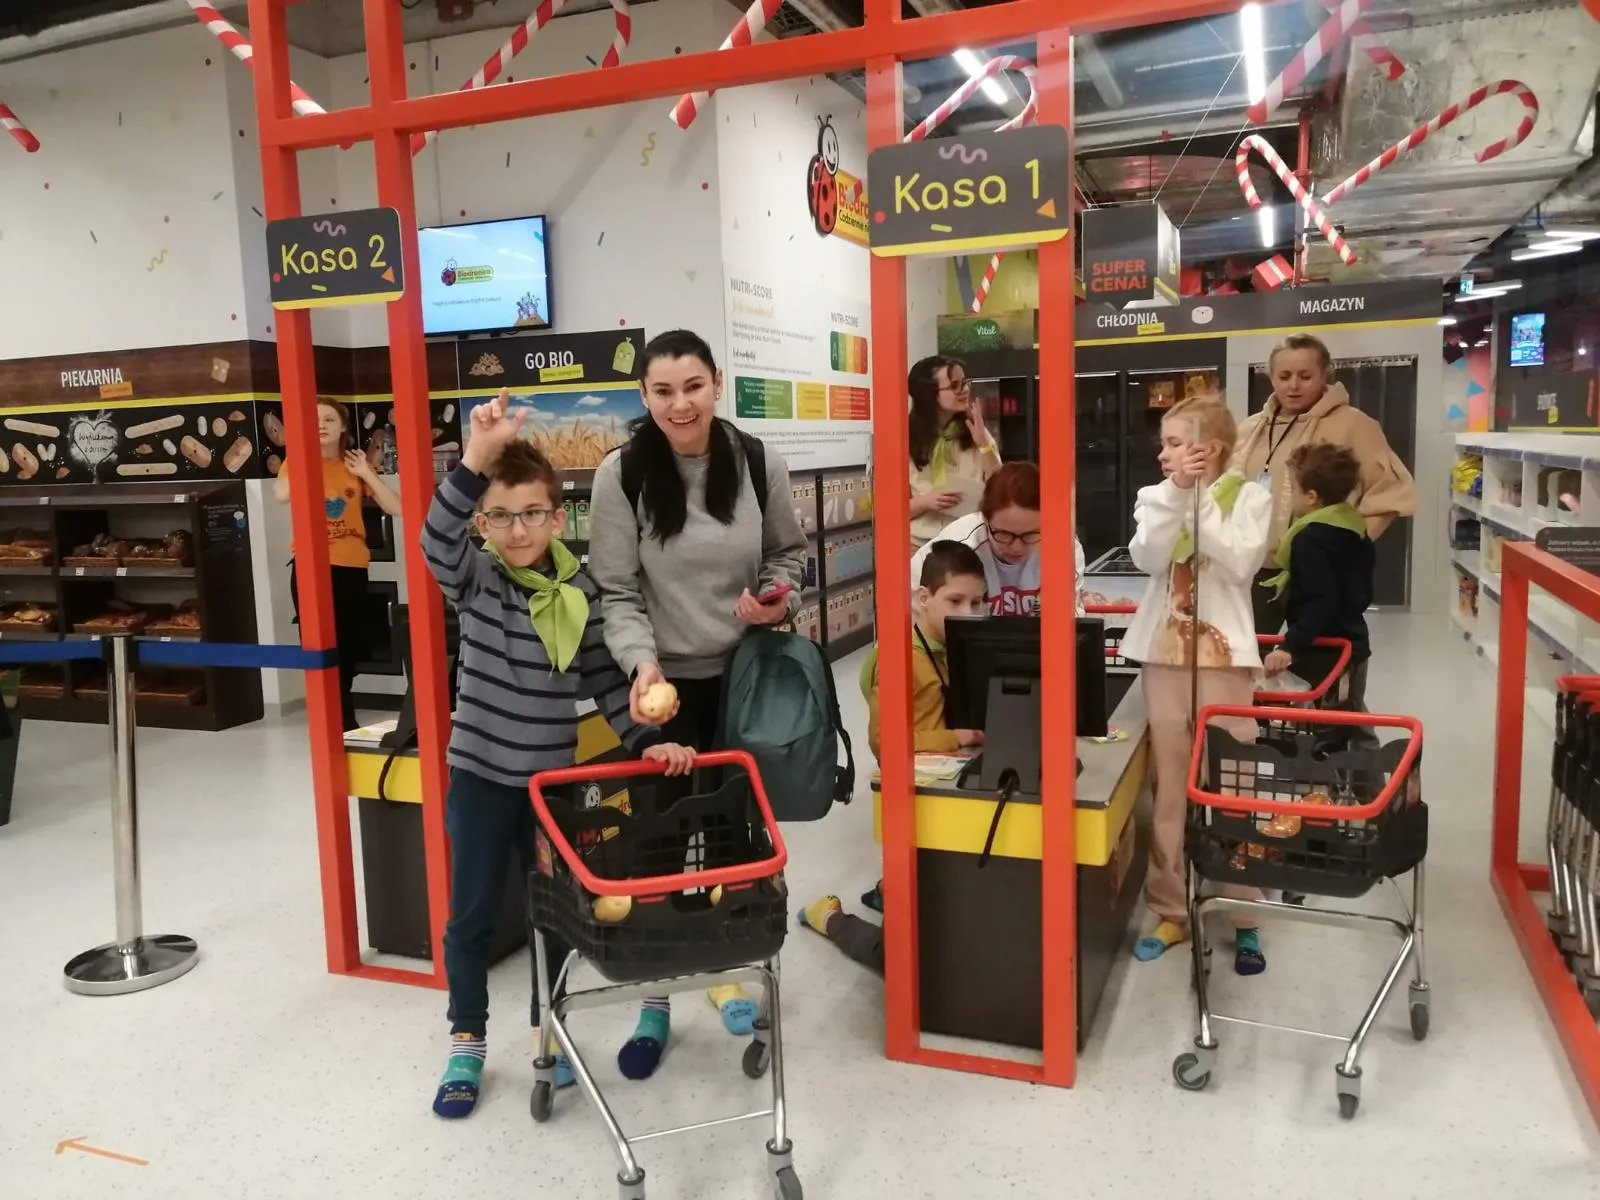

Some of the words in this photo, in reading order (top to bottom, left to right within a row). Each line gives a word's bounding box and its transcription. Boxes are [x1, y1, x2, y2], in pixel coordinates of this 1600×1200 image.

[894, 173, 1007, 214] Kasa
[1024, 158, 1040, 200] 1
[281, 243, 358, 276] Kasa
[368, 234, 386, 268] 2
[1092, 258, 1146, 276] SUPER
[730, 277, 773, 300] NUTRI-SCORE
[1090, 274, 1148, 292] CENA!
[1300, 297, 1365, 314] MAGAZYN
[1096, 312, 1158, 328] CHŁODNIA
[524, 352, 546, 370] GO
[549, 351, 574, 369] BIO
[60, 367, 124, 388] PIEKARNIA
